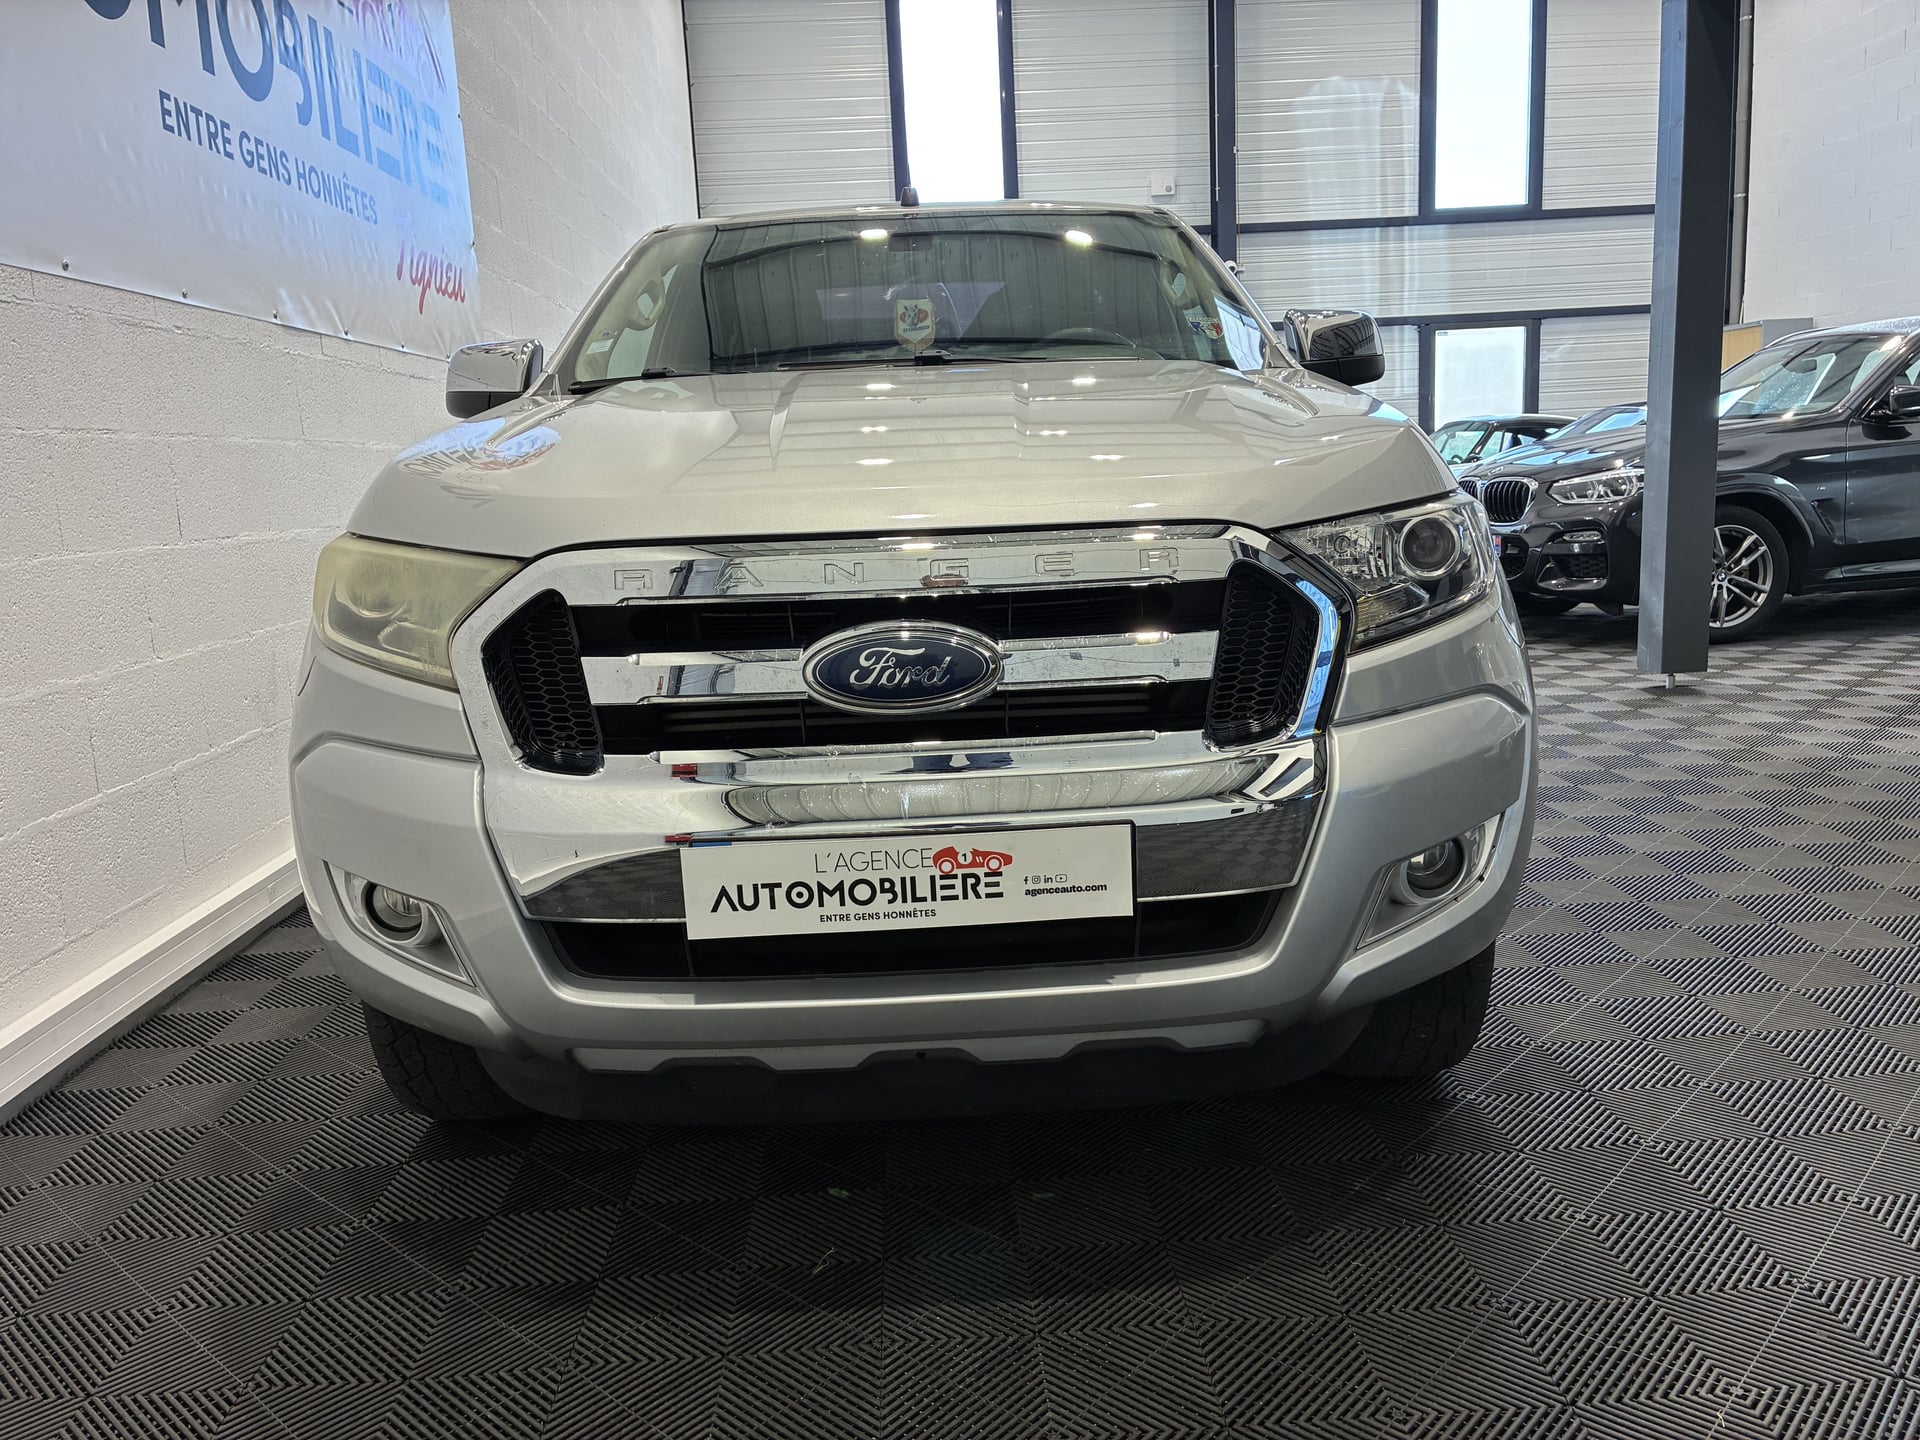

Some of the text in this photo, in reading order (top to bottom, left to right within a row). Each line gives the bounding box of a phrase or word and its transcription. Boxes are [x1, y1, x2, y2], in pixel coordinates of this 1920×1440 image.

[84, 0, 450, 208] MOBILIERE
[158, 88, 379, 226] ENTRE GENS HONNÊTES
[613, 547, 1180, 591] RANGER
[849, 646, 952, 690] Ford
[814, 847, 934, 874] L'AGENCE
[710, 870, 1004, 913] AUTOMOBILIERE
[1024, 883, 1107, 897] agenceauto.com
[819, 907, 937, 923] ENTRE GENS HONNÊTES
